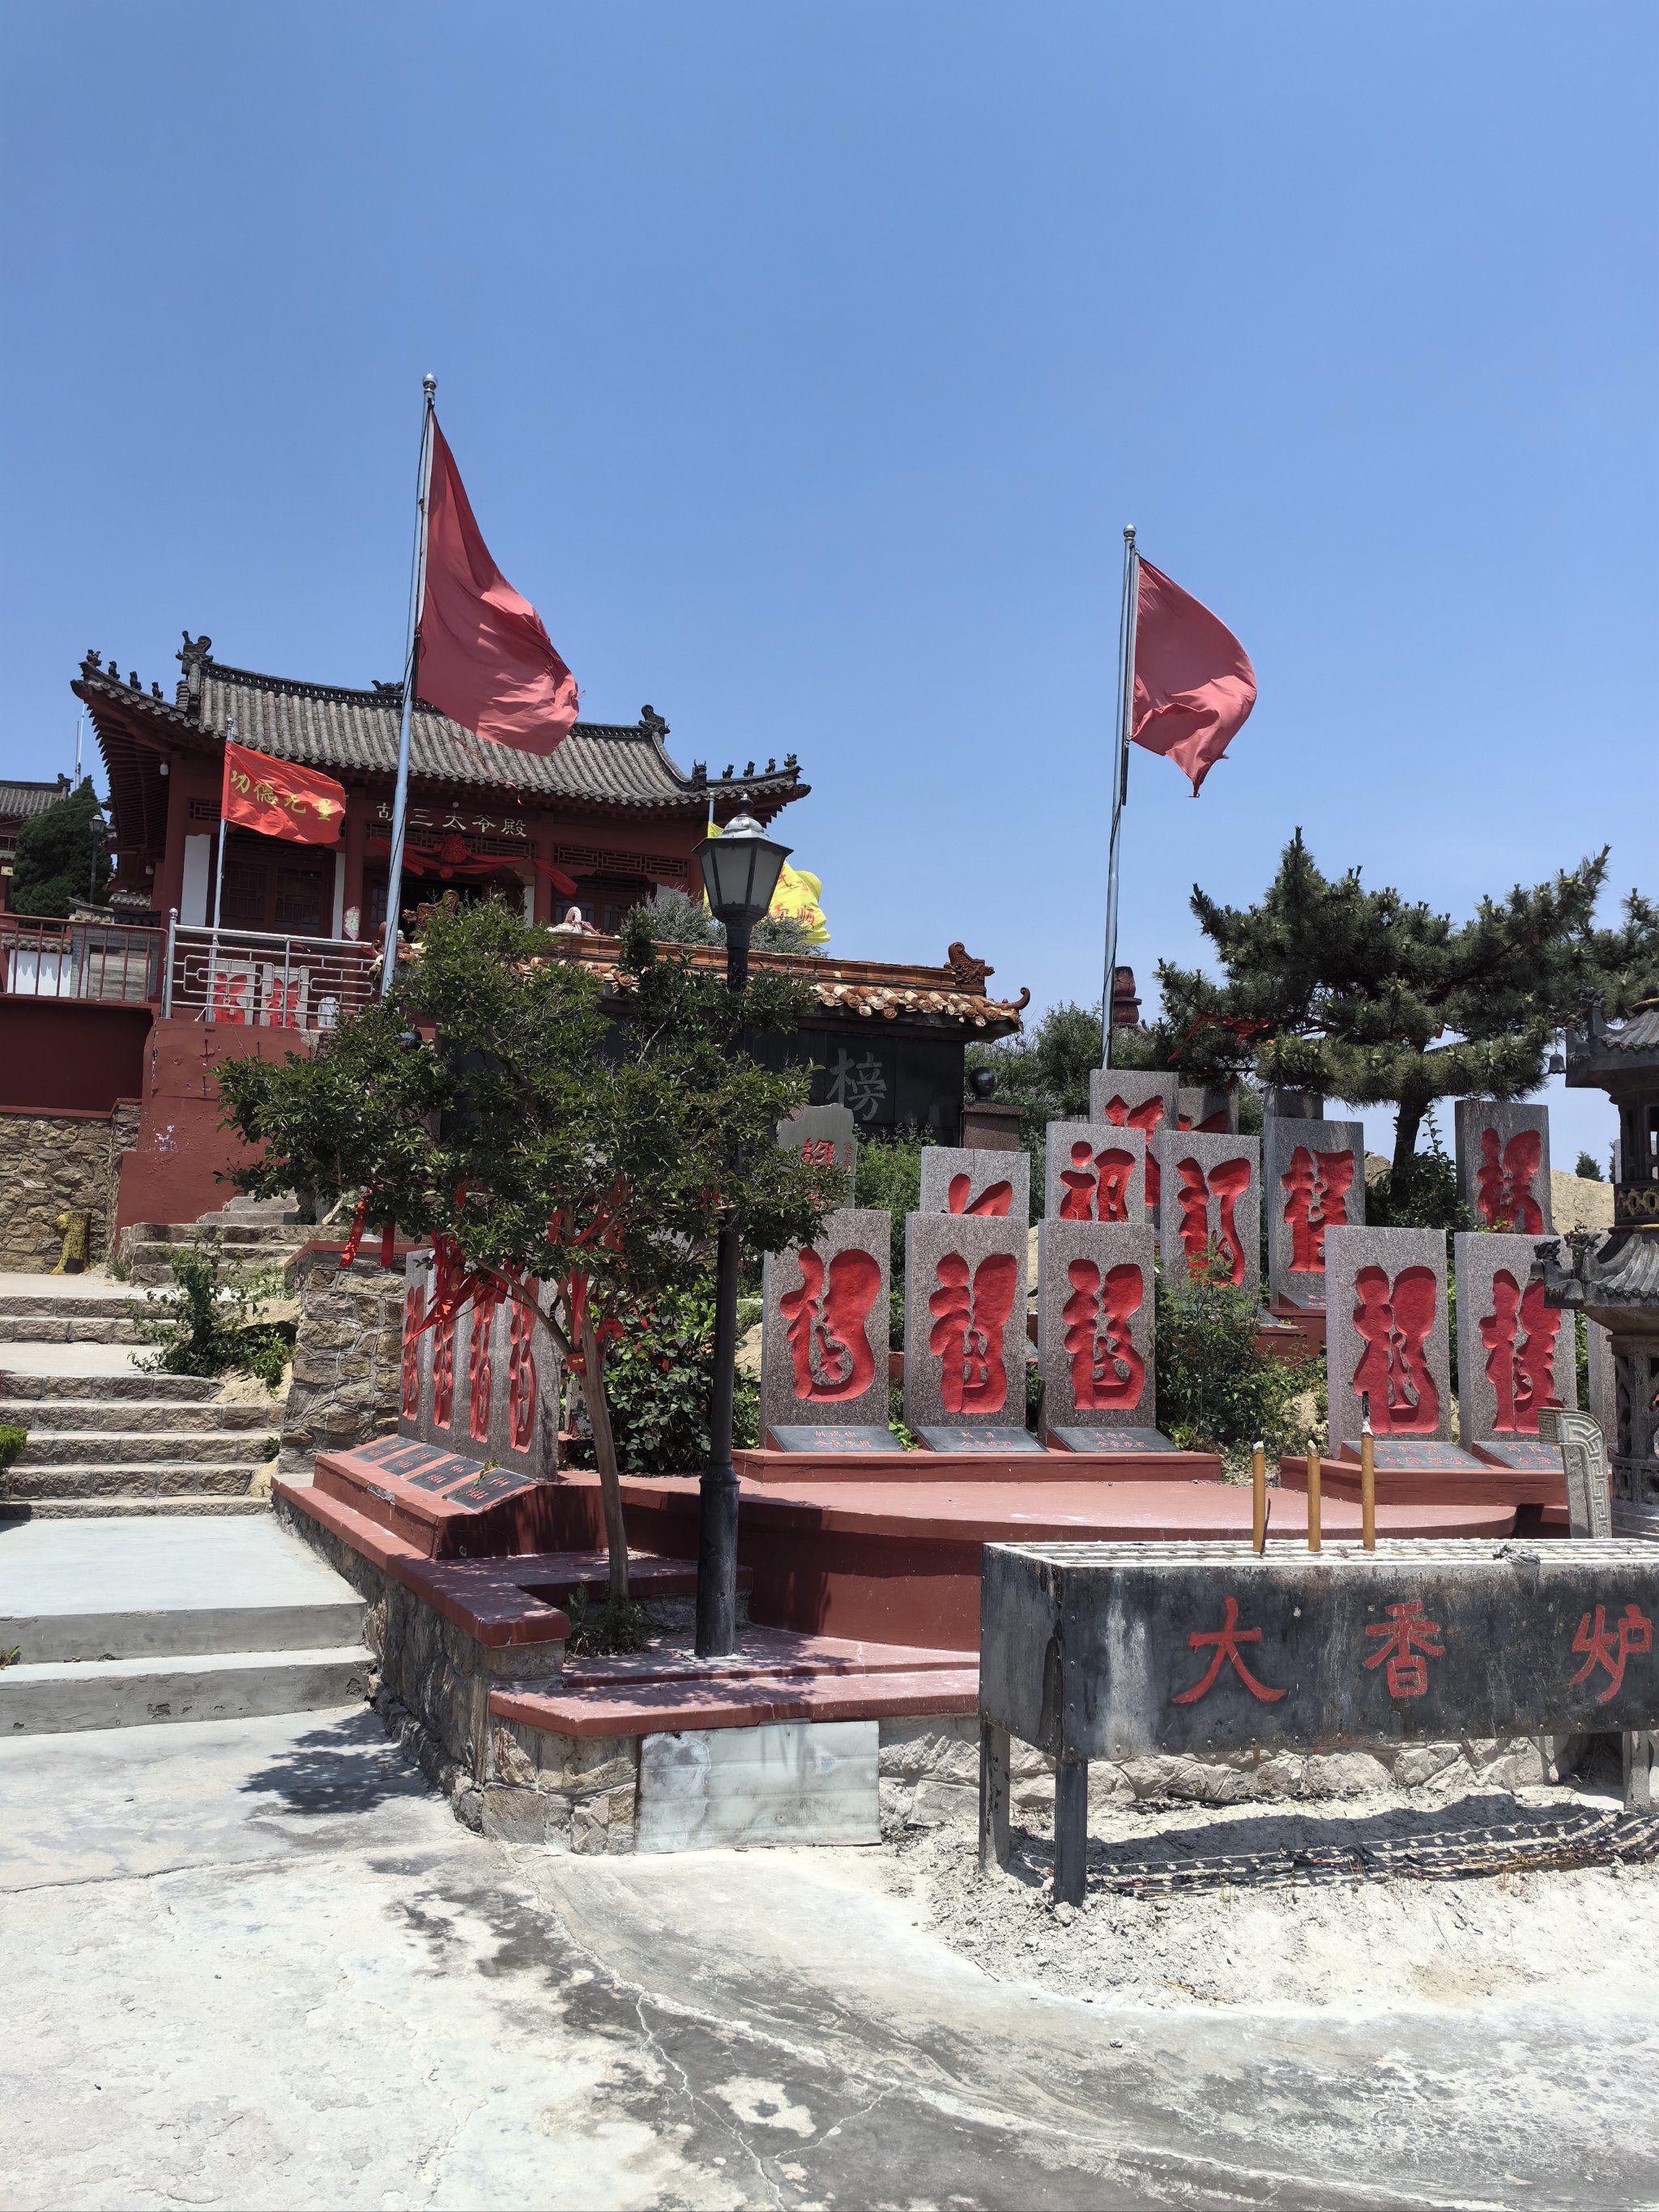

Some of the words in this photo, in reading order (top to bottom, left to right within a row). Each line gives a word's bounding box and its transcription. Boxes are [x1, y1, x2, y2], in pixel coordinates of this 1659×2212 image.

[230, 769, 333, 821] 功德无量
[1171, 1595, 1653, 1704] 大香炉
